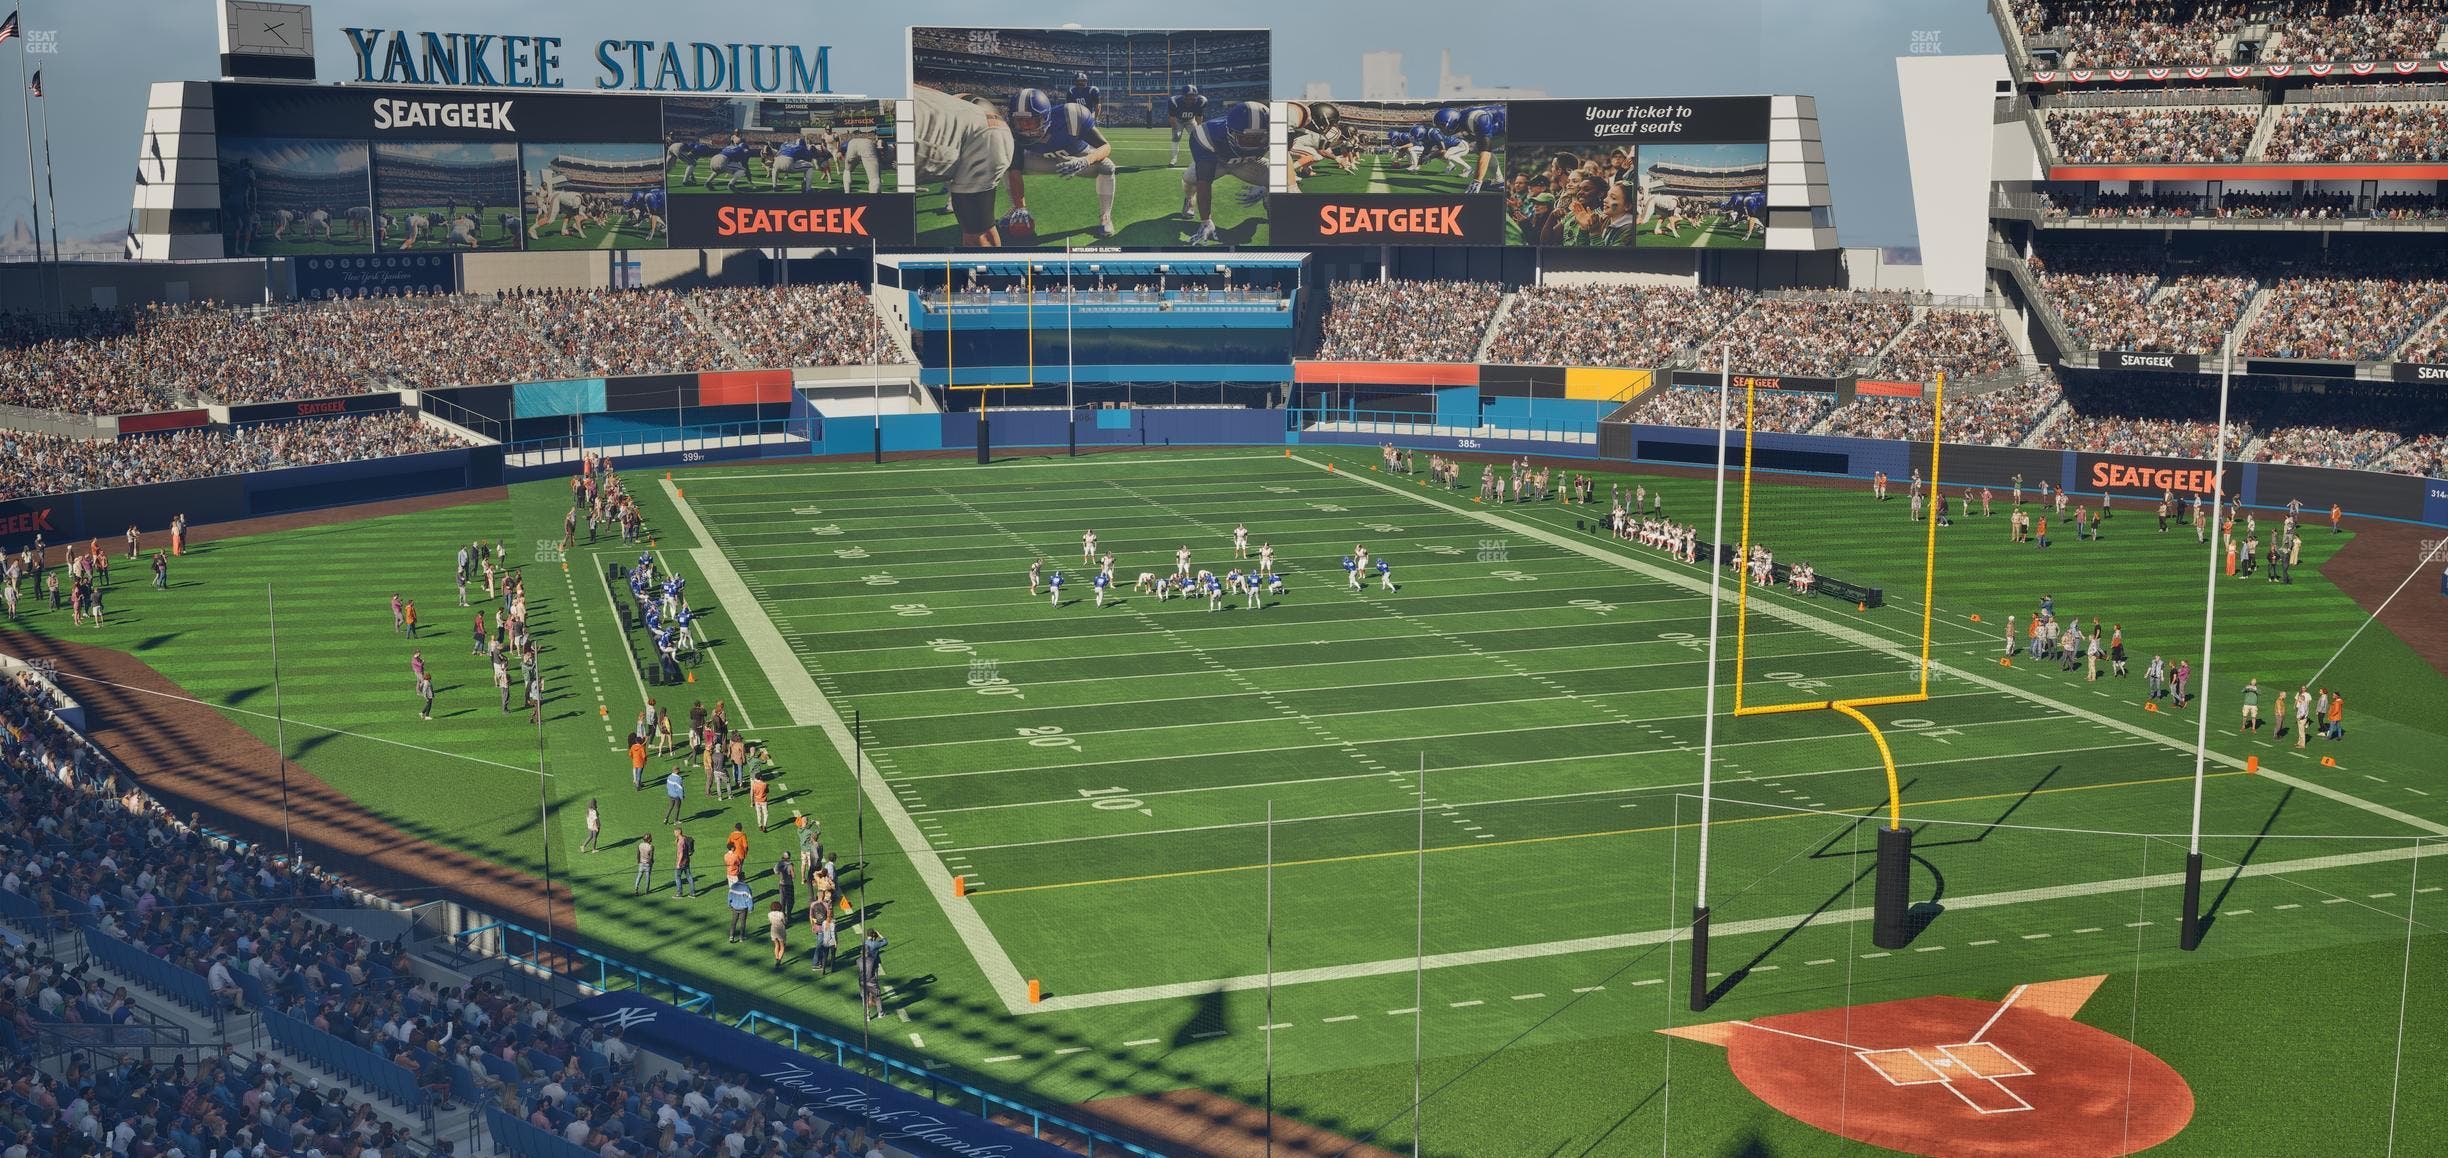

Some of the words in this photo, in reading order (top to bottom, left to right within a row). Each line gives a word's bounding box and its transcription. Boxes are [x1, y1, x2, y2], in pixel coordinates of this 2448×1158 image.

[339, 27, 564, 88] YANKEE
[594, 38, 833, 94] STADIUM
[373, 98, 515, 131] SEATGEEK
[1585, 106, 1624, 121] Your
[1627, 105, 1673, 119] ticket
[1675, 105, 1692, 118] to
[1594, 121, 1637, 138] great
[1640, 120, 1682, 133] seats
[717, 205, 869, 237] SEATGEEK
[1320, 204, 1464, 237] SEATGEEK
[2121, 354, 2174, 368] SEATGEEK
[1733, 376, 1780, 389] SEAGEEK
[2418, 367, 2448, 379] SEAT
[298, 400, 346, 415] SEATGEEK
[2092, 462, 2226, 496] SEATGEEK
[1015, 725, 1076, 747] 20
[1078, 786, 1145, 810] 10
[760, 1062, 832, 1094] New
[804, 1088, 920, 1124] York
